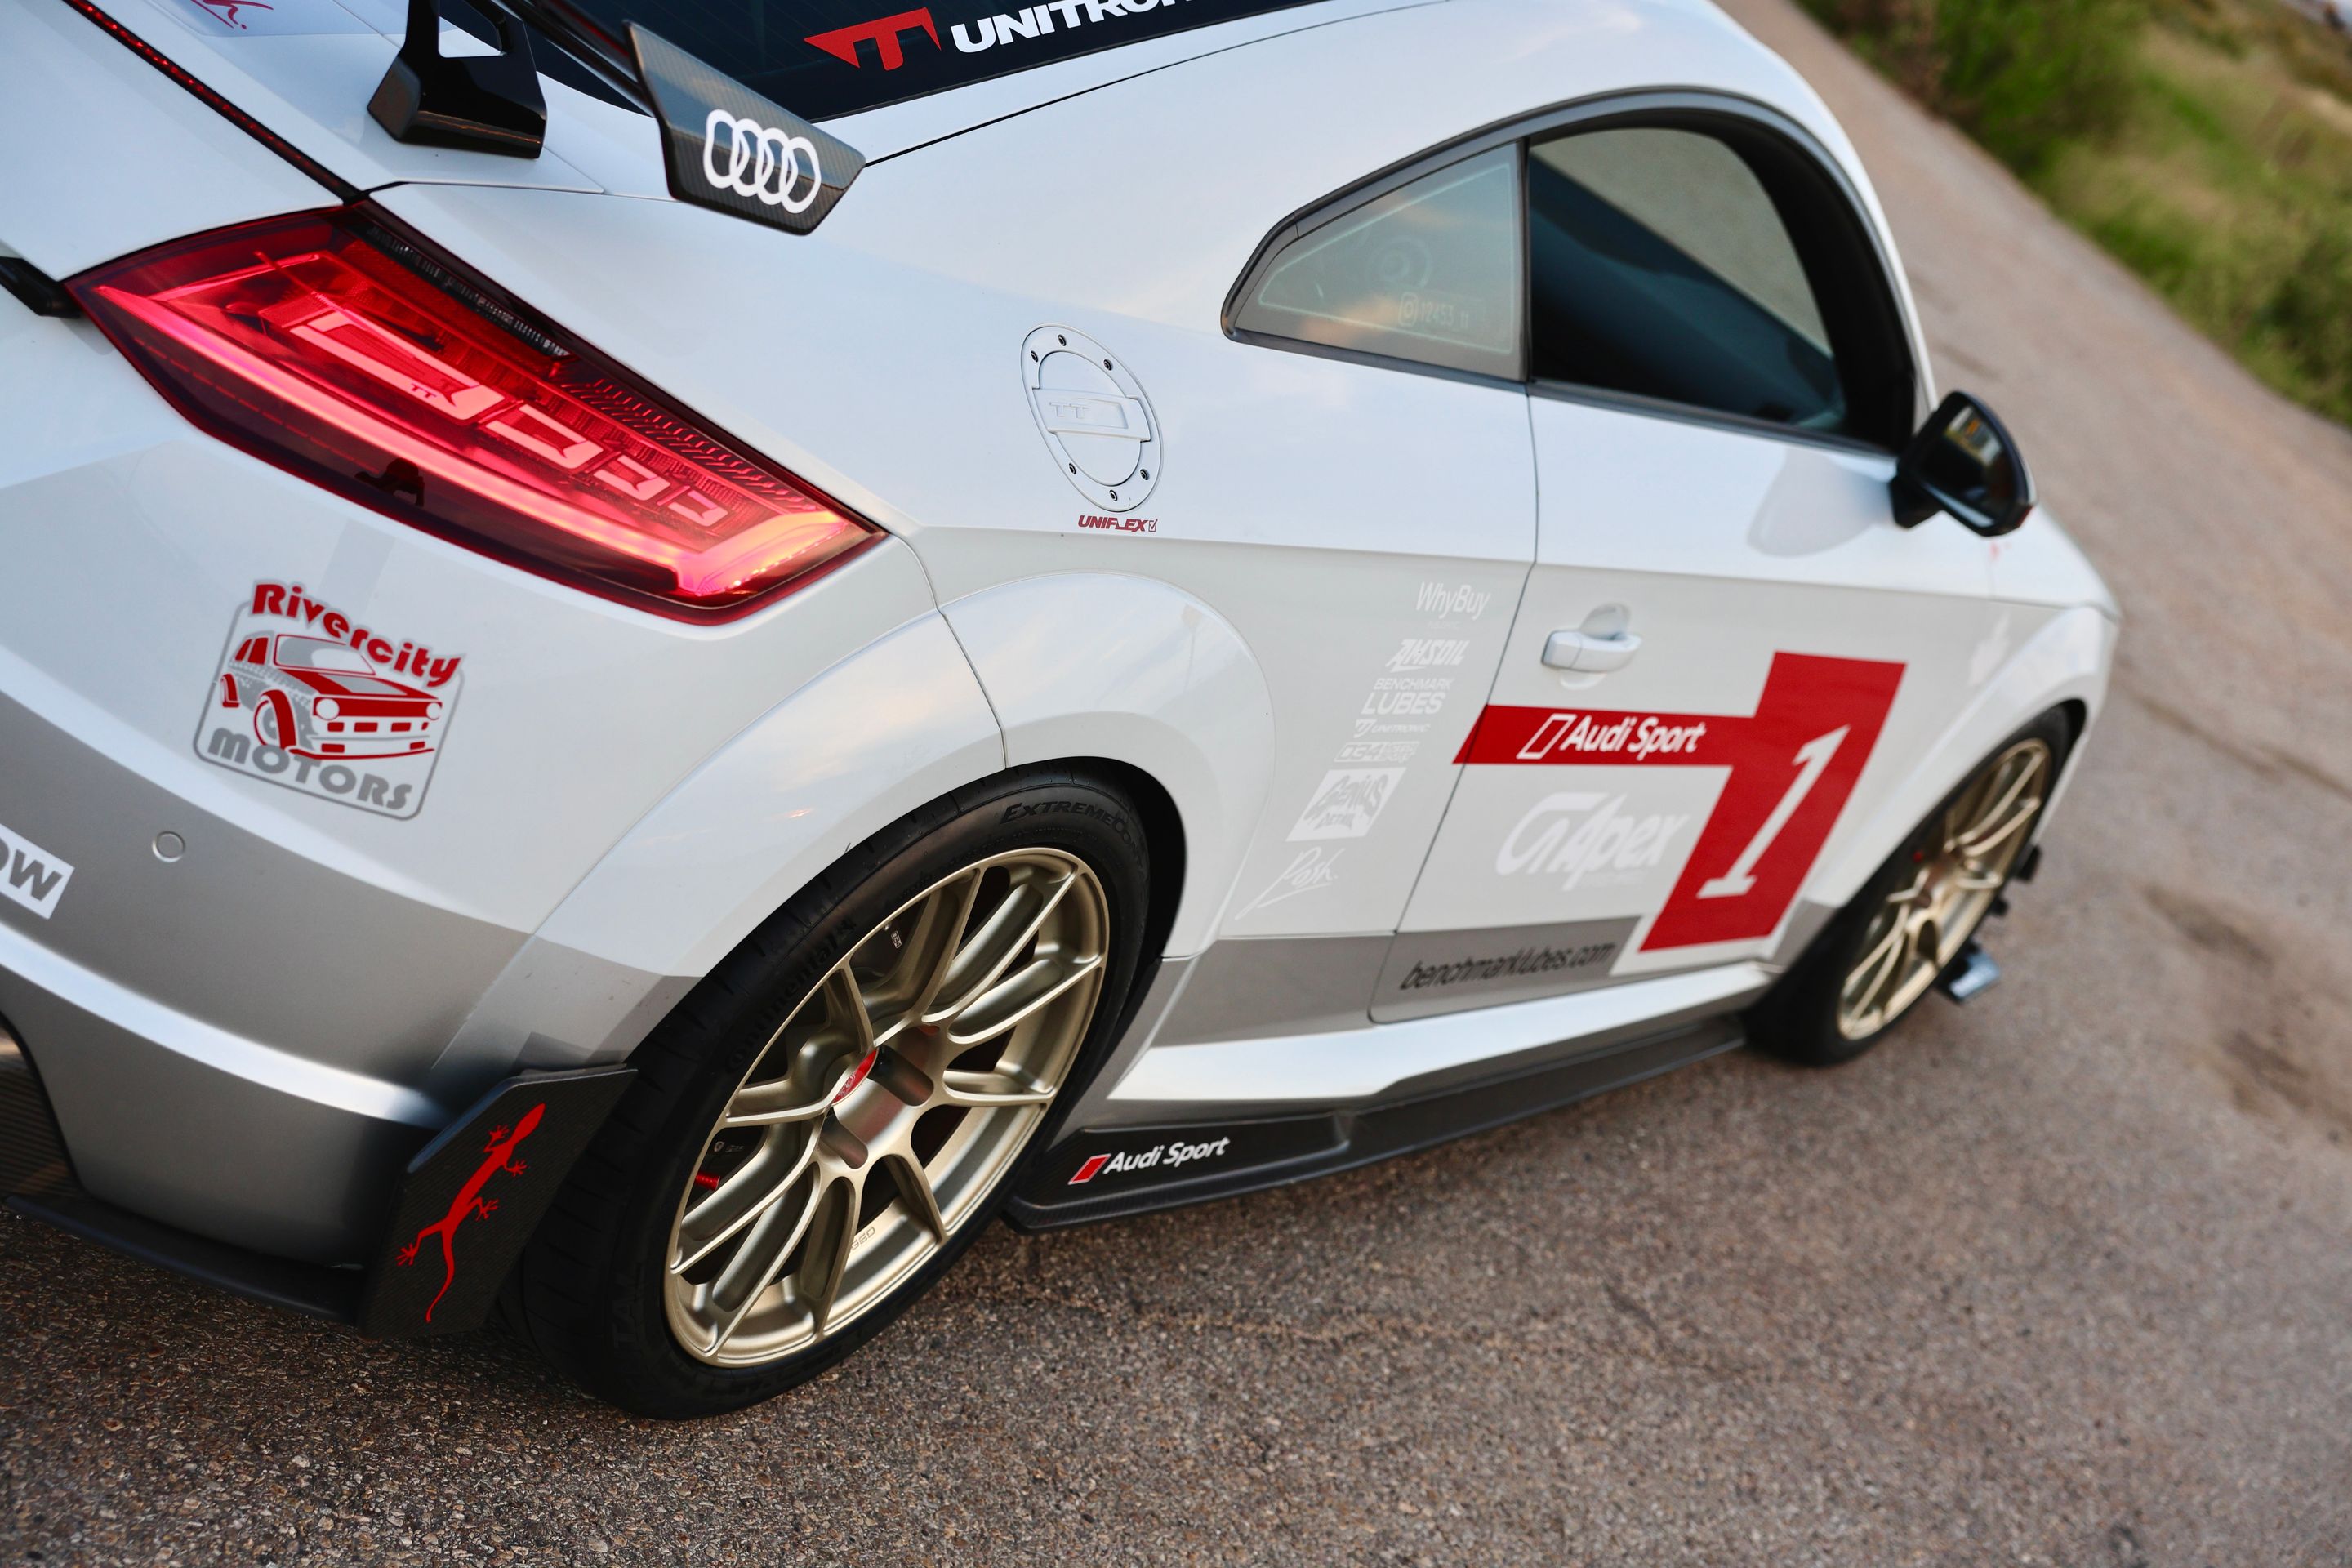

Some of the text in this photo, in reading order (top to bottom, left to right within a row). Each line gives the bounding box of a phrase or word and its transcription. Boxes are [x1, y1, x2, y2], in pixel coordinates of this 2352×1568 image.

[411, 382, 438, 399] TT
[1049, 401, 1090, 419] TT
[1077, 514, 1149, 532] UNIFLEX
[1415, 581, 1491, 621] WhyBuy
[252, 583, 462, 688] Rivercity
[1384, 638, 1470, 673] AMSOIL
[1374, 677, 1455, 691] BENCHMARK
[1361, 691, 1447, 715] LUBES
[1559, 715, 1707, 761] Audi Sport
[1695, 723, 1852, 899] 1
[1399, 942, 1617, 991] benchmarklubes.com
[1102, 1136, 1232, 1174] Audi Sport
